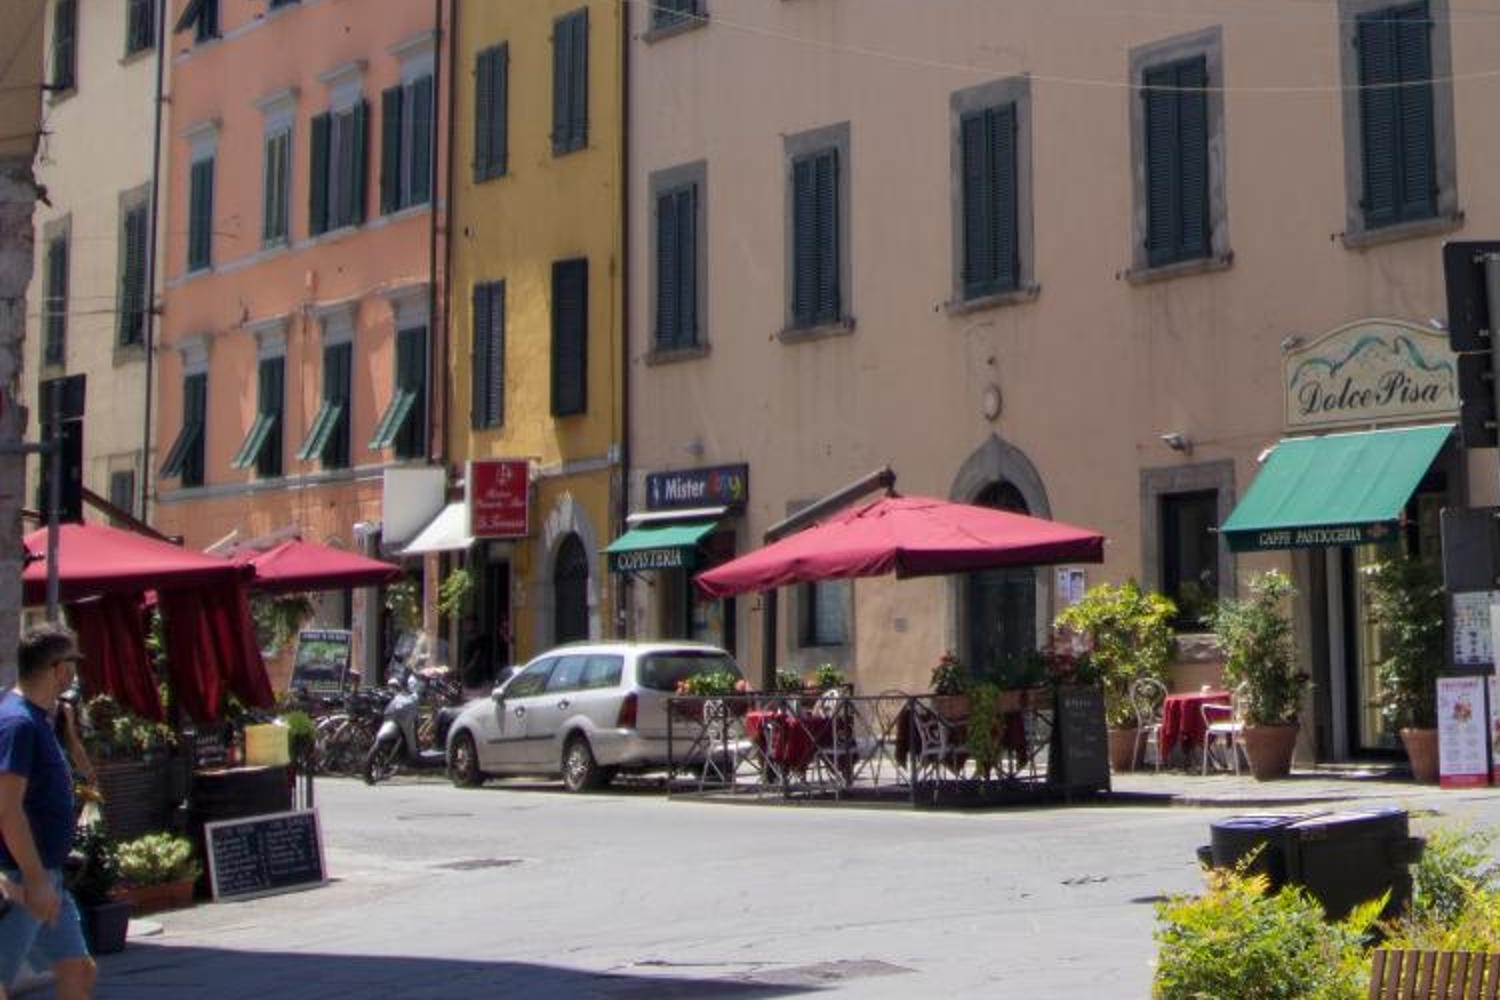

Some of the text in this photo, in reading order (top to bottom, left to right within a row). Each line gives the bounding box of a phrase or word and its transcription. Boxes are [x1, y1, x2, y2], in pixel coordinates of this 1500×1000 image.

[1298, 369, 1440, 416] Dolce Pisa
[665, 477, 705, 501] Mister
[617, 547, 683, 570] COPISTERIA
